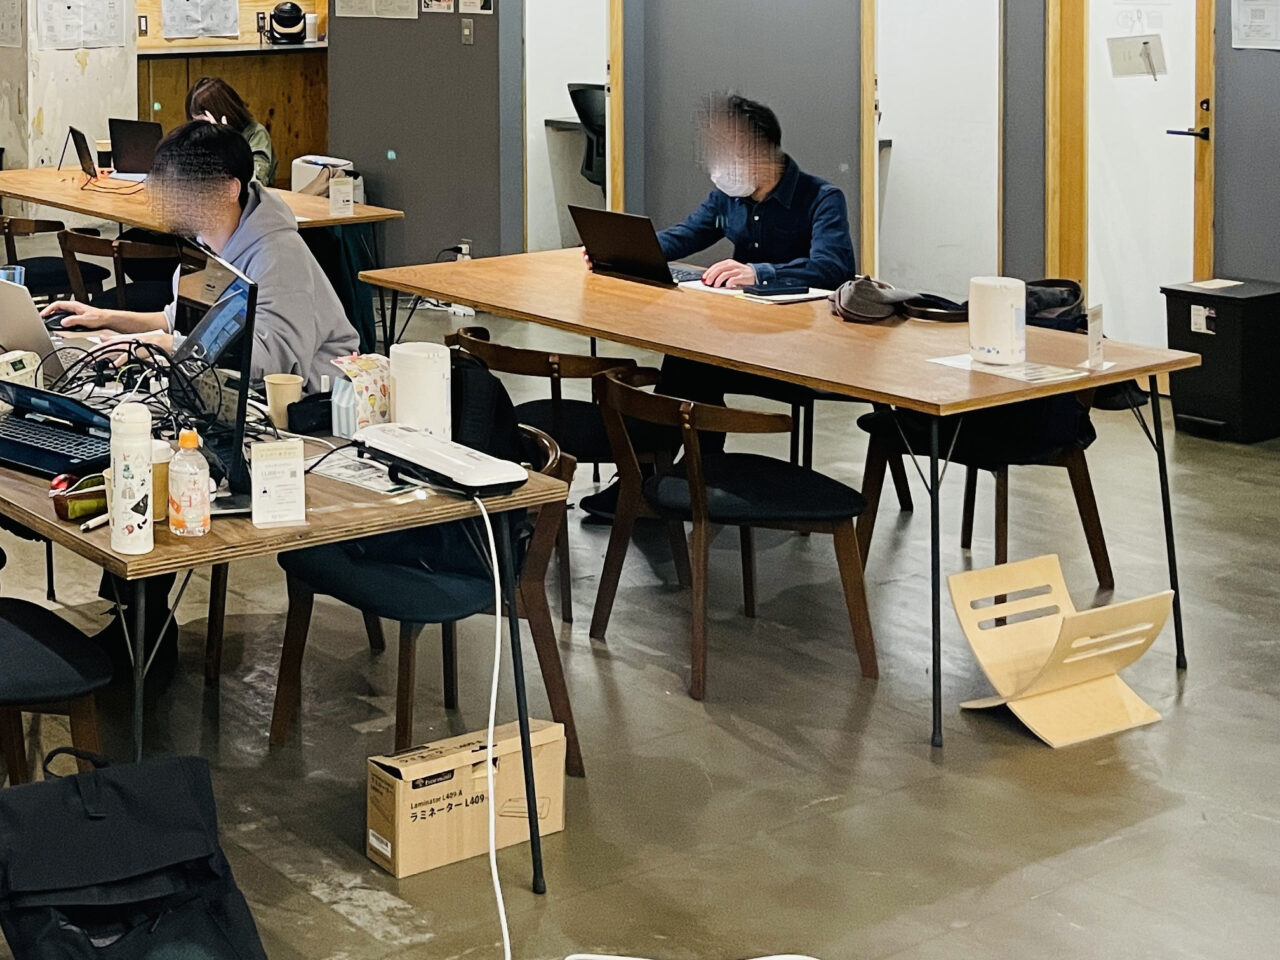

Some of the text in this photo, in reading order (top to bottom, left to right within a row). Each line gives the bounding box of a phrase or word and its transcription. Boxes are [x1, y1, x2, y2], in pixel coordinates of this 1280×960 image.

[410, 802, 463, 823] ラミネーター
